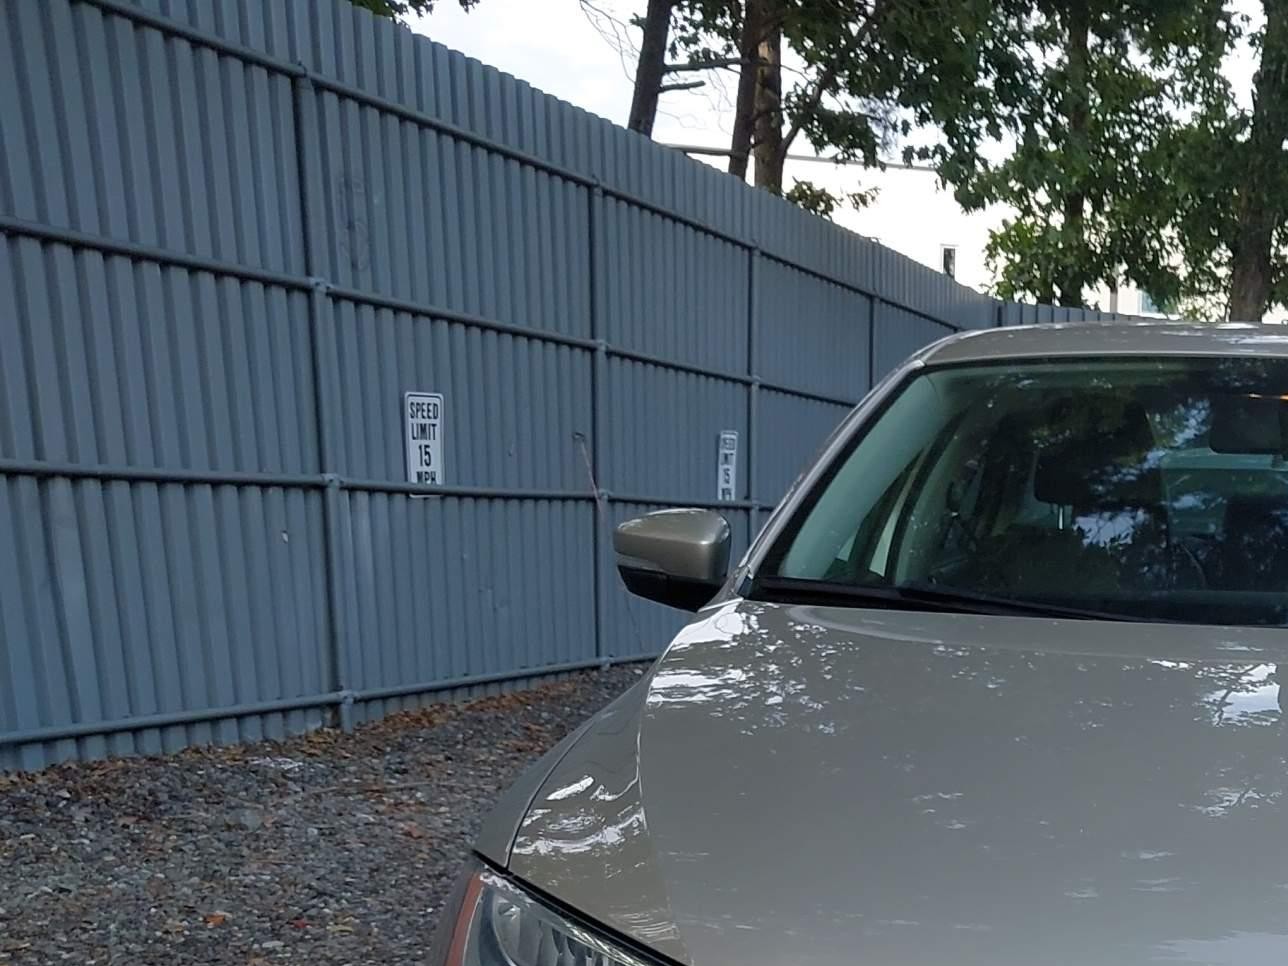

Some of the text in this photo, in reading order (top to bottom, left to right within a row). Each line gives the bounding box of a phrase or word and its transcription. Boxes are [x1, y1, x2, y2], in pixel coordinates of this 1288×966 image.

[409, 402, 439, 419] SPEED
[411, 422, 438, 440] LIMIT
[418, 444, 432, 467] 15
